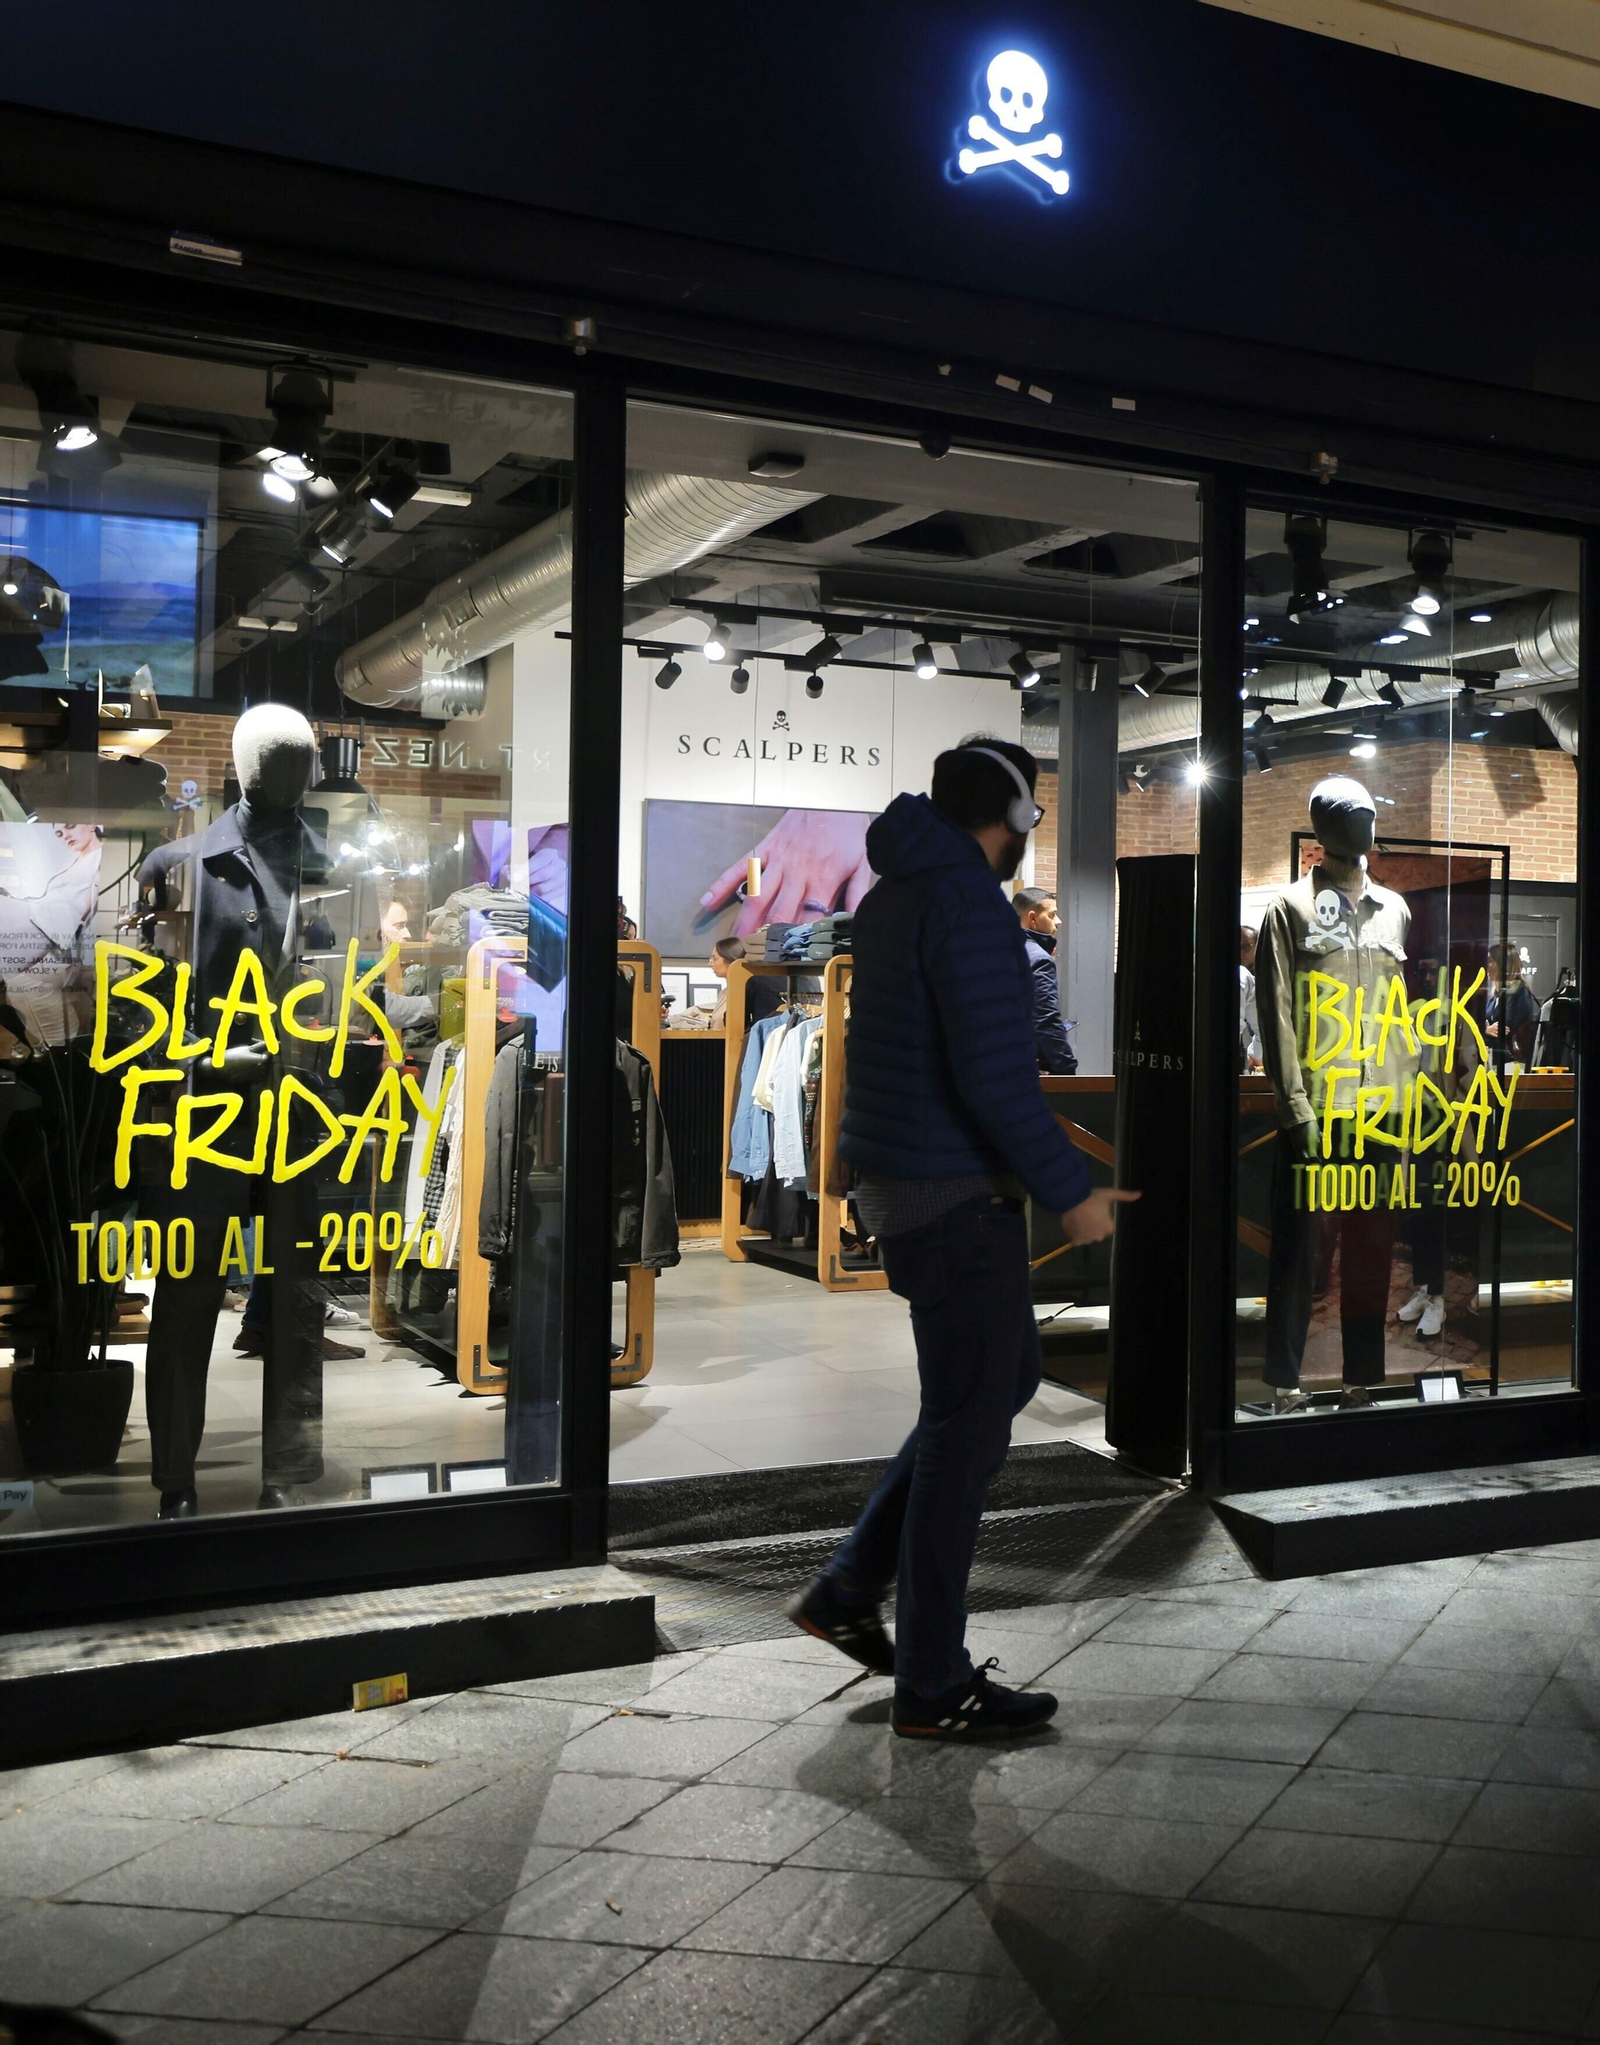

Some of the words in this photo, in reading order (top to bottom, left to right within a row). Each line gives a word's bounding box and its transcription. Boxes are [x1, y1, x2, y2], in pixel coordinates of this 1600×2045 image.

[678, 734, 881, 767] SCALPERS
[115, 1066, 457, 1190] FRIDAY
[1322, 1064, 1521, 1160] FRIDAY
[1306, 1164, 1376, 1212] TODO
[1389, 1163, 1422, 1210] AL
[1434, 1161, 1521, 1207] -20%
[71, 1220, 196, 1286] TODO
[219, 1215, 274, 1278] AL
[296, 1211, 443, 1274] -20%
[4, 1489, 27, 1501] Pay
